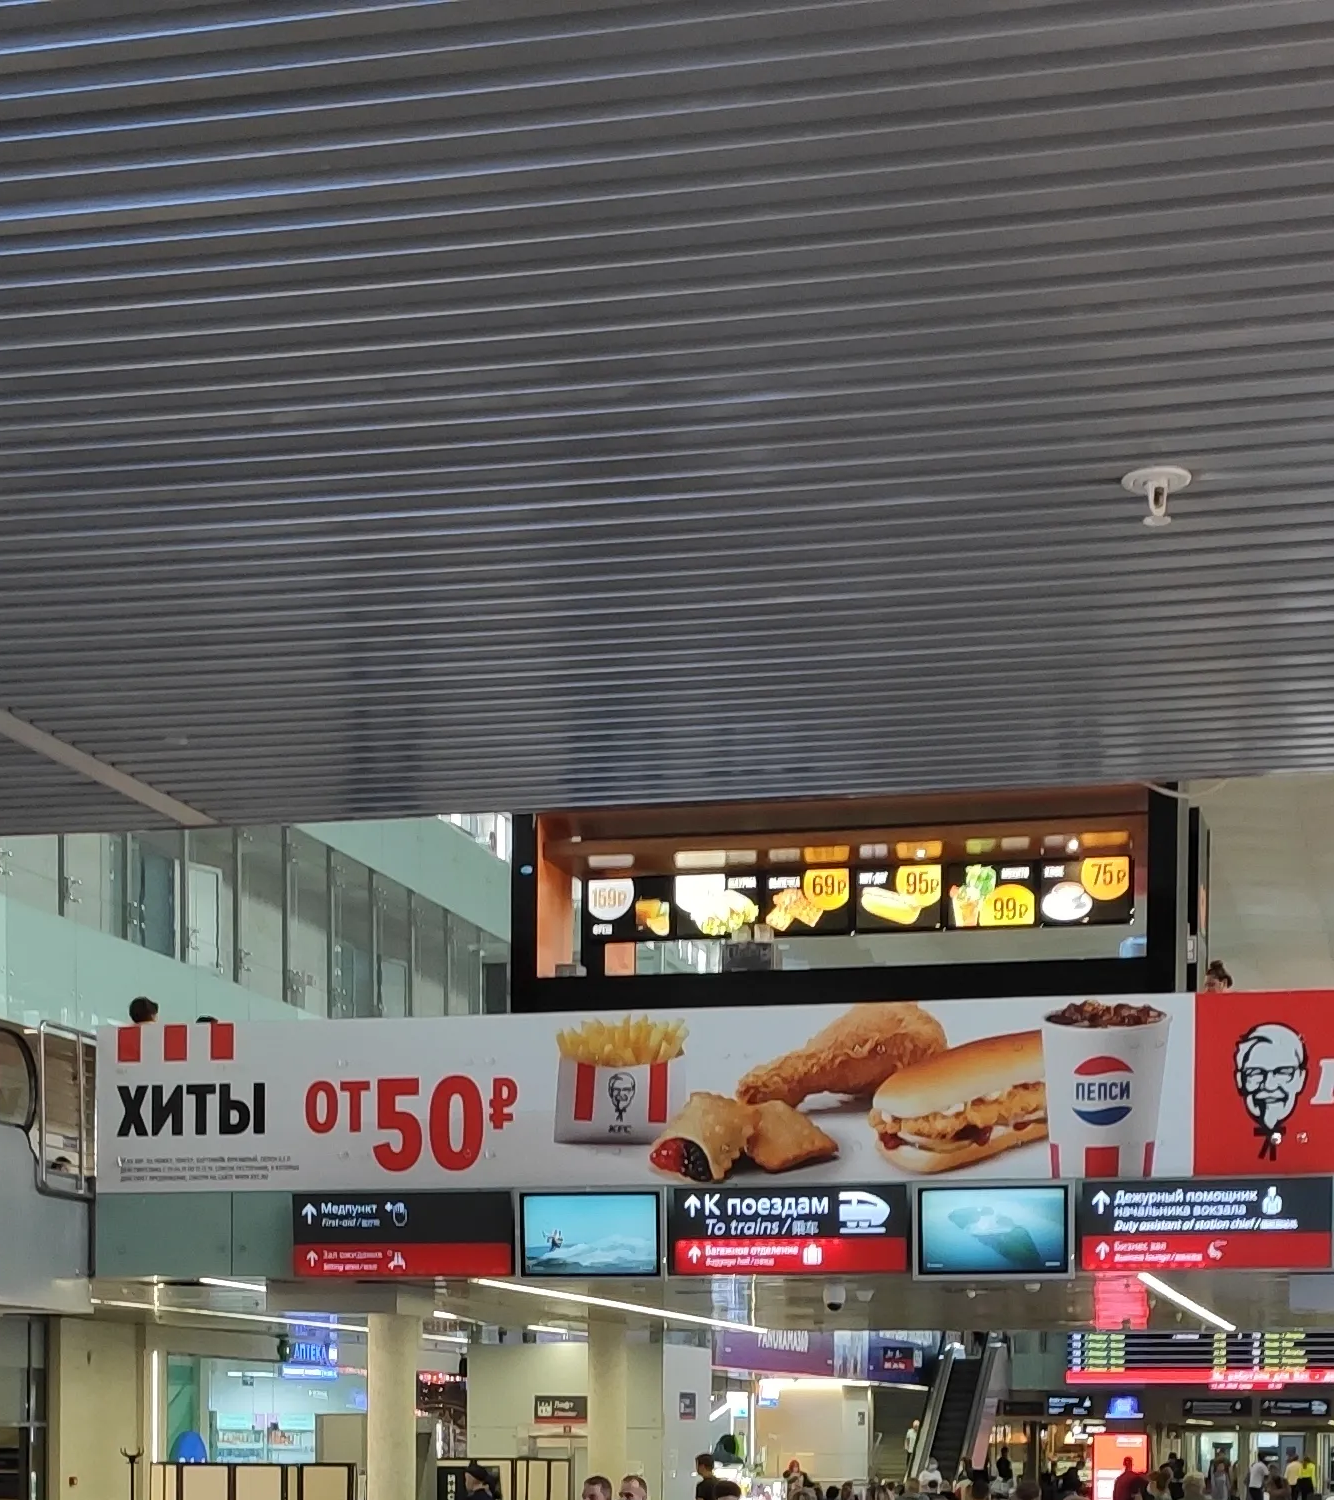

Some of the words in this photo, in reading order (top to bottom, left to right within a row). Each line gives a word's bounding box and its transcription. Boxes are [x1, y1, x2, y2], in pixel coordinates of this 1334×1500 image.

[1075, 1081, 1131, 1101] ПЕПСИ
[117, 1082, 266, 1137] ХИТЫ
[704, 1193, 721, 1216] К
[727, 1196, 829, 1218] поездам
[1114, 1188, 1184, 1207] Дежурный
[1185, 1190, 1258, 1204] помощник
[321, 1201, 378, 1217] Медпункт
[1114, 1203, 1191, 1217] начальника
[1193, 1203, 1247, 1217] вокзала
[705, 1218, 726, 1236] To
[729, 1217, 779, 1236] trains
[1114, 1219, 1138, 1234] Duty
[1138, 1218, 1182, 1232] assistant
[1182, 1216, 1195, 1231] of
[1194, 1217, 1230, 1231] station
[1230, 1216, 1257, 1230] chief
[293, 1342, 328, 1362] АПТЕКА
